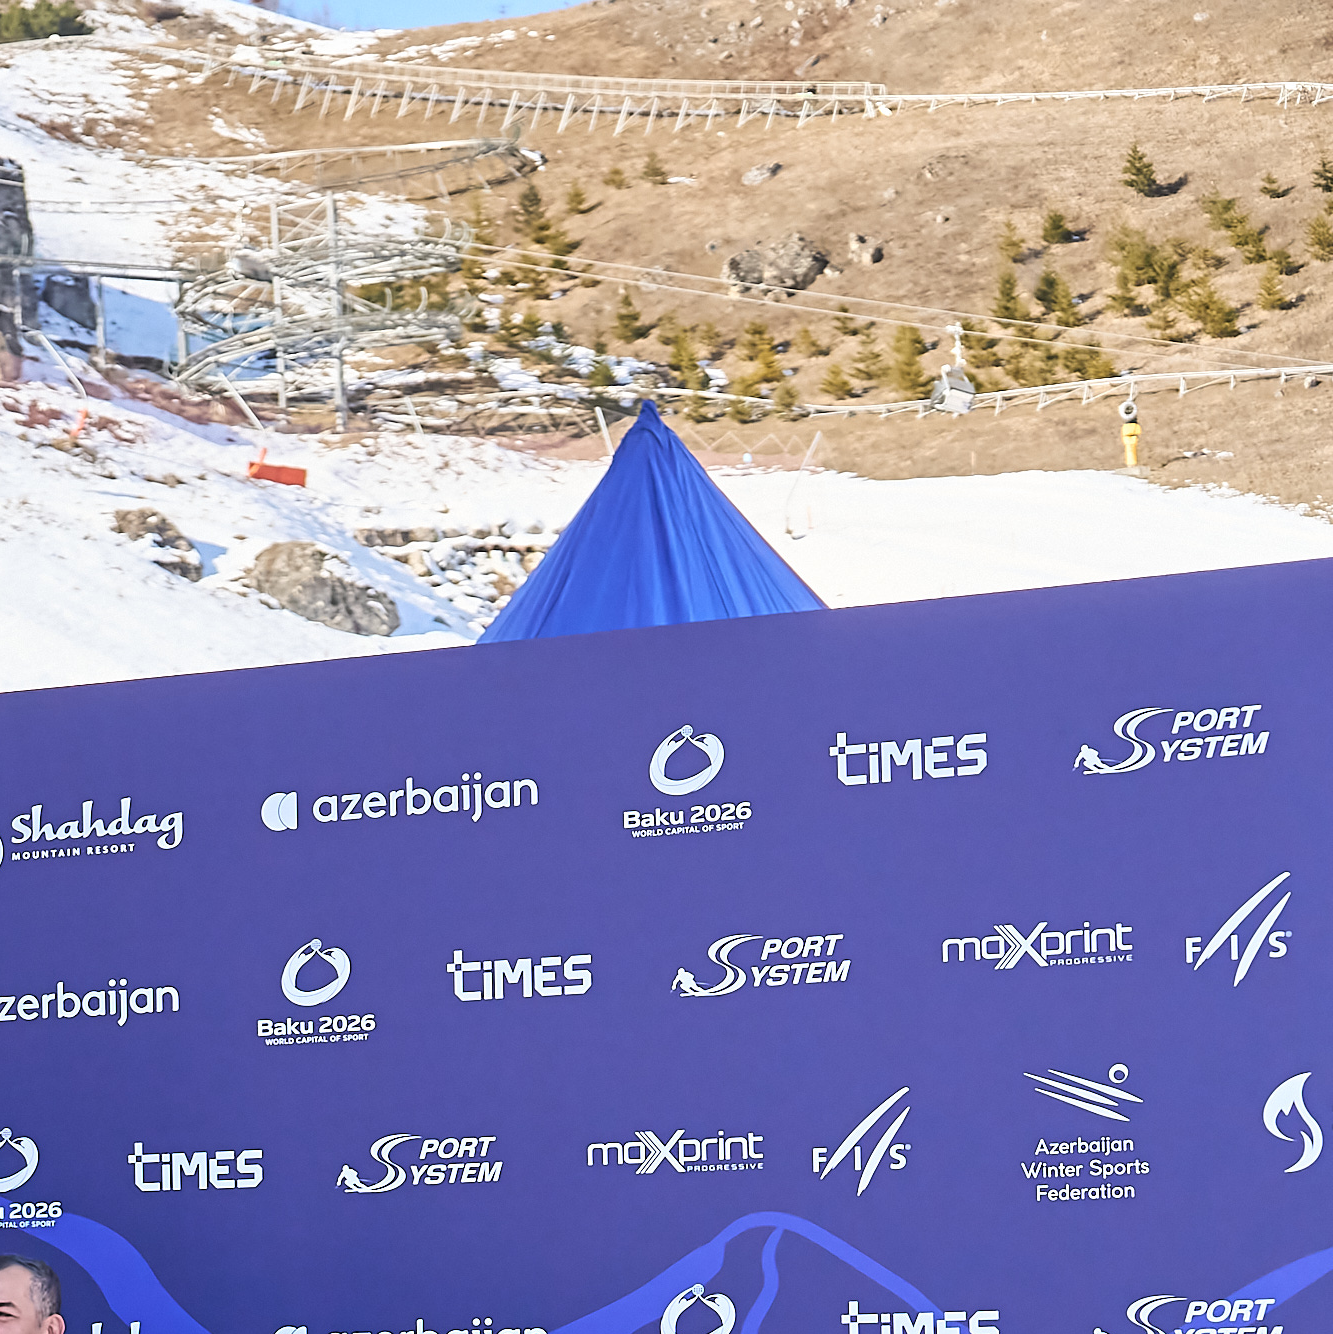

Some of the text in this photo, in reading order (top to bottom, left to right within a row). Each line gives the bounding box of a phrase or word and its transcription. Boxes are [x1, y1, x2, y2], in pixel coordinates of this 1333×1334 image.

[312, 771, 539, 823] azerbaijan
[10, 796, 185, 850] Shahdag
[623, 801, 752, 829] Baku 2026
[631, 822, 744, 838] WORLD CAPITAL OF SPORT
[11, 843, 135, 861] MOUNTAIN RESORT
[1049, 954, 1134, 967] PROGRESSIVE
[257, 1013, 376, 1037] Baku 2026
[265, 1037, 295, 1045] WORLD
[296, 1036, 328, 1044] CAPITAL
[343, 1033, 369, 1041] SPORT
[1034, 1136, 1134, 1157] Azerbaijan
[686, 1162, 765, 1173] PROGRESSIVE
[1020, 1159, 1150, 1180] Winter Sports
[1036, 1183, 1136, 1202] Federation
[9, 1201, 63, 1219] 2026
[19, 1220, 30, 1228] OF
[32, 1219, 56, 1228] SPORT
